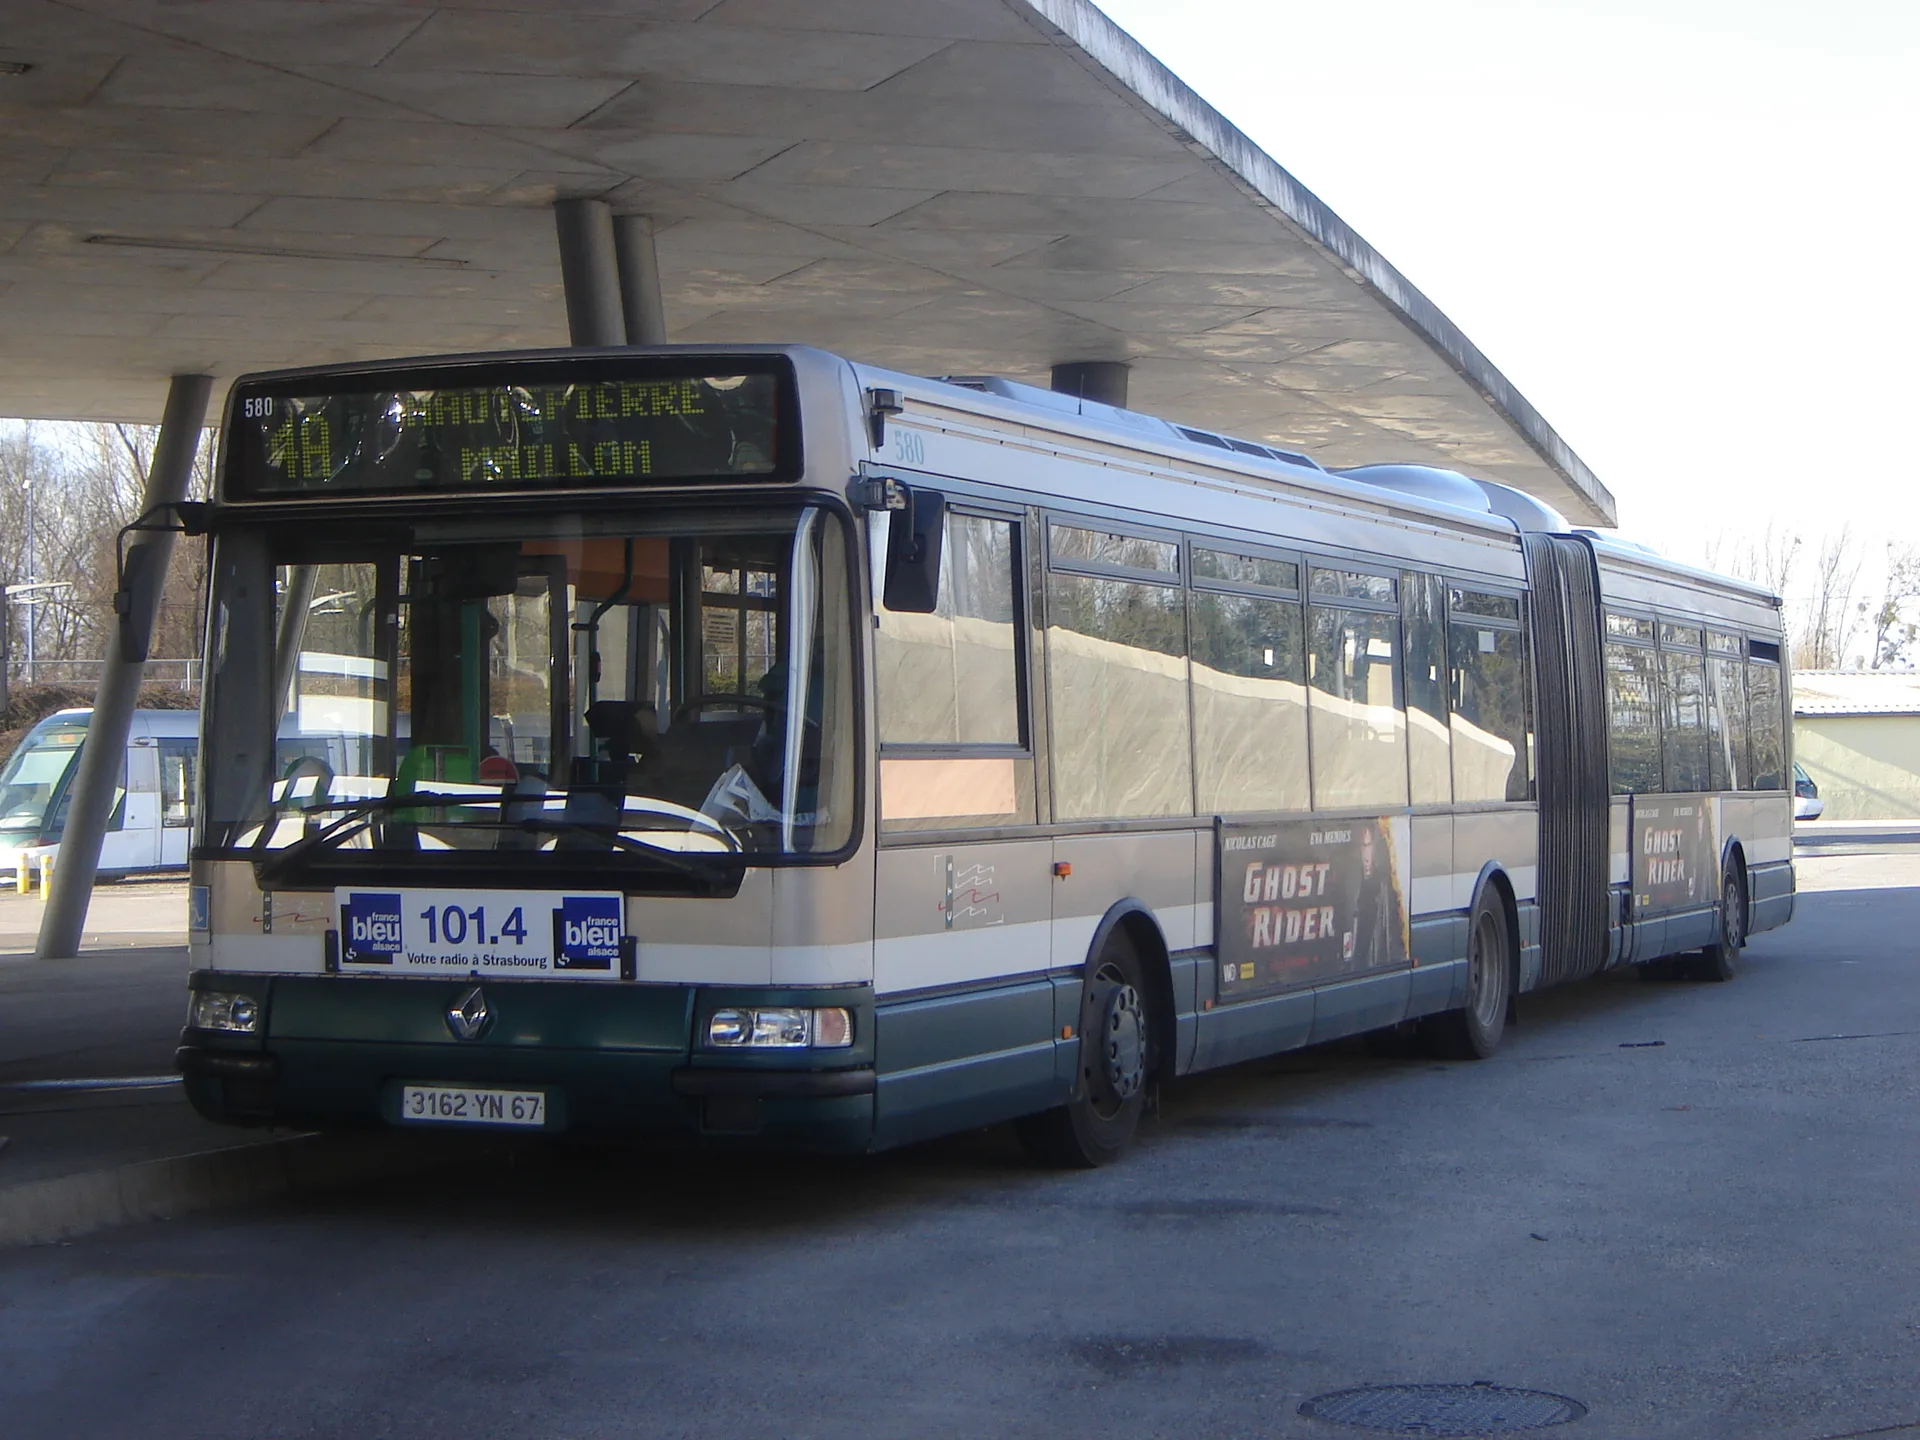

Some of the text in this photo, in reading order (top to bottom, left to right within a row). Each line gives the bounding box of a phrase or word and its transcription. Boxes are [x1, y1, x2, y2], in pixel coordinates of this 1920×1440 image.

[244, 396, 273, 418] 580
[894, 429, 925, 466] 580
[461, 440, 651, 481] MAILLON
[1224, 834, 1277, 851] NICOLAS CAGE
[1323, 829, 1352, 844] MENDES
[1643, 826, 1683, 854] GHOST
[1242, 861, 1330, 903] GHOST
[1648, 857, 1685, 886] RIDER
[352, 916, 401, 941] bleu
[371, 911, 400, 923] france
[420, 905, 528, 945] 101.4
[587, 915, 619, 927] france
[1252, 906, 1335, 948] RIDER
[565, 920, 619, 946] bleu
[372, 942, 401, 952] alsace
[587, 945, 619, 957] alsace
[407, 952, 548, 969] Votre radio à Strasbourg
[411, 1091, 540, 1120] 3162 YN 67
